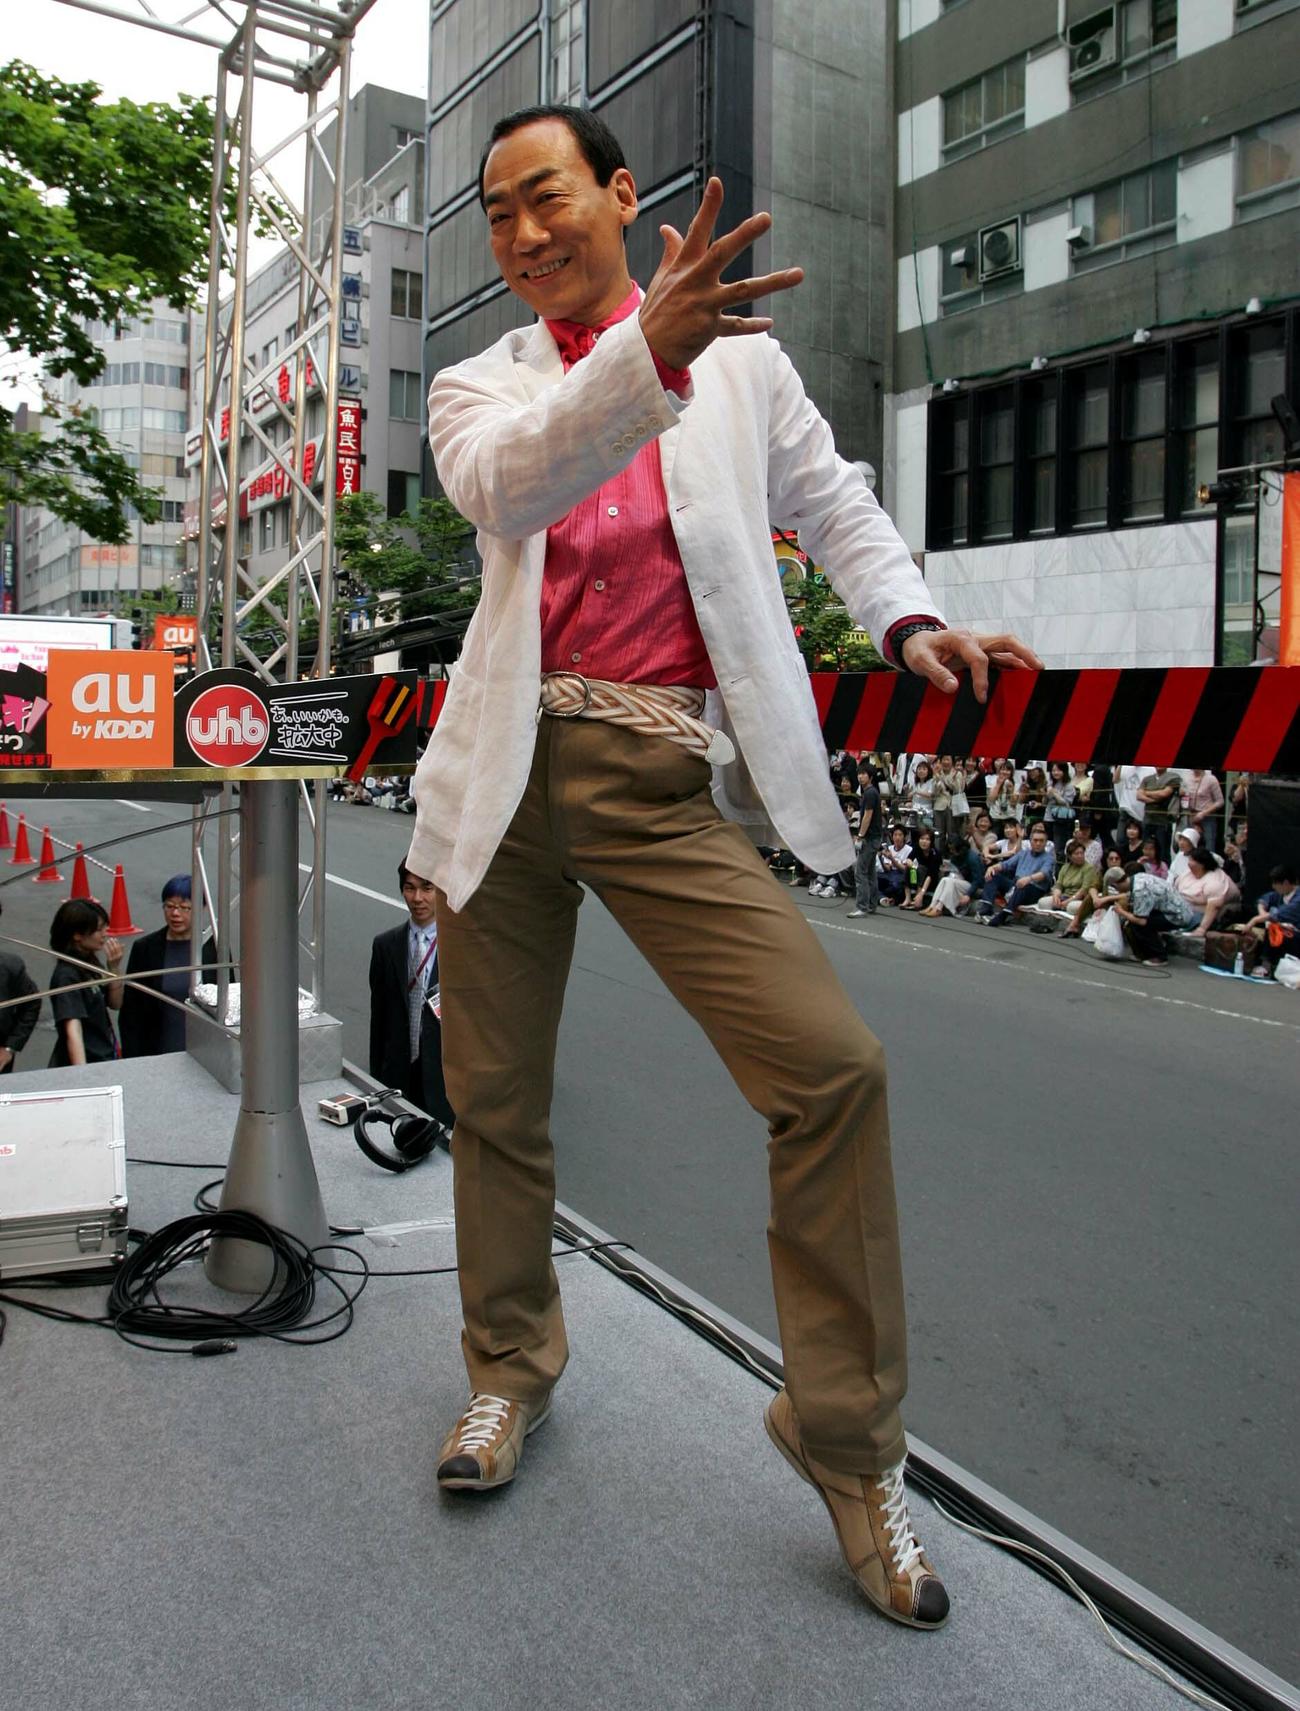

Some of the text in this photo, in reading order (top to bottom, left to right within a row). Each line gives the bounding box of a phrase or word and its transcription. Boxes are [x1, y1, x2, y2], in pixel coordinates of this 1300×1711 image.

[339, 408, 358, 450] 魚民
[163, 626, 194, 643] au
[71, 673, 156, 714] au
[71, 719, 155, 740] by KDDI
[189, 704, 269, 746] uhb
[277, 723, 343, 749] 拡大中
